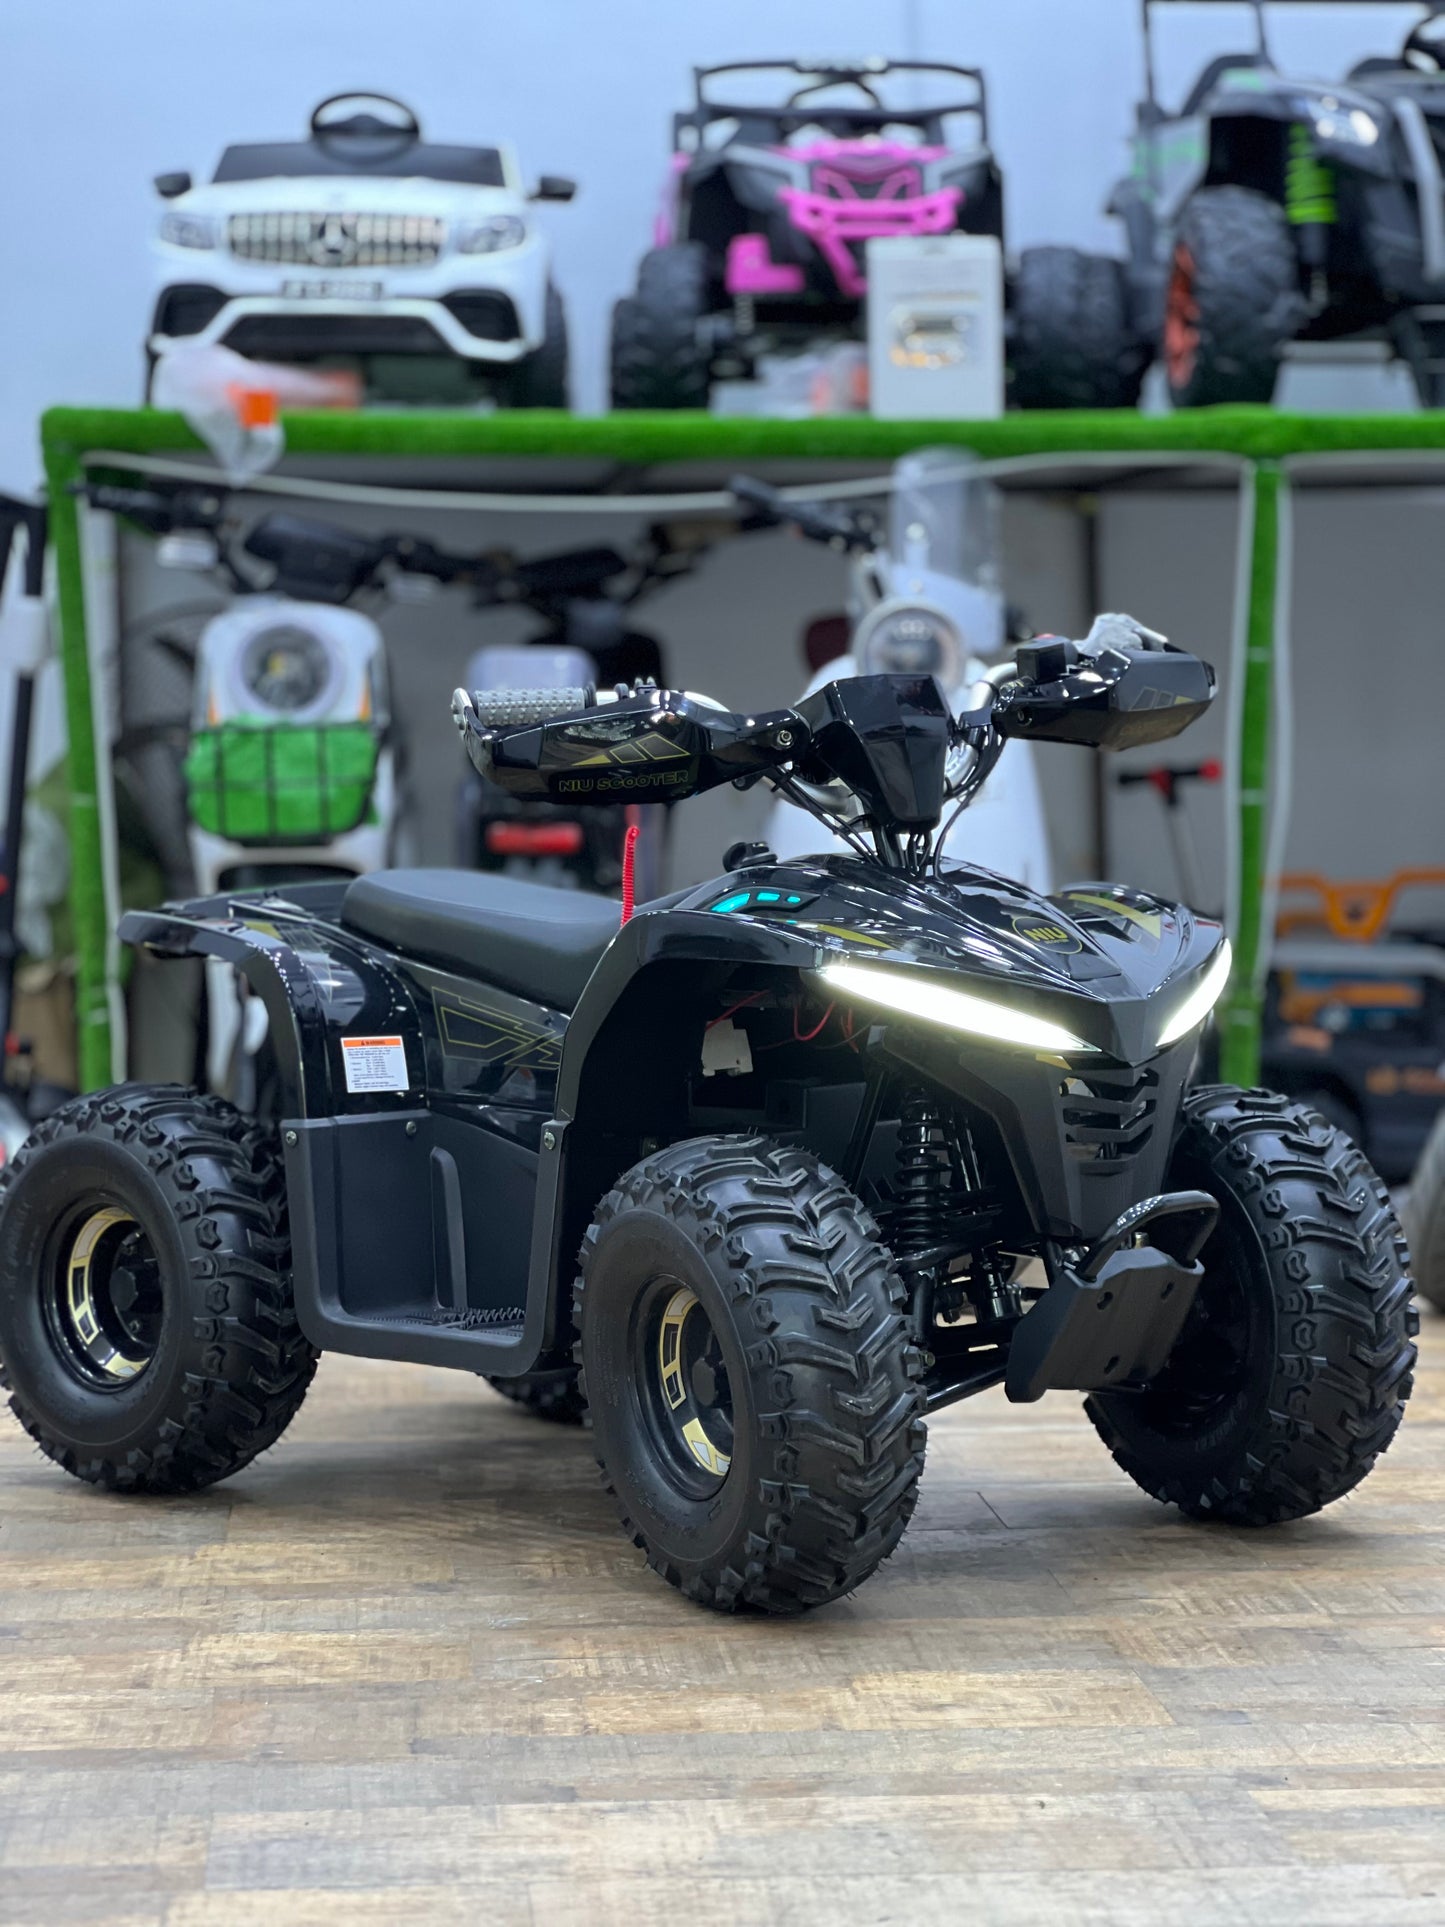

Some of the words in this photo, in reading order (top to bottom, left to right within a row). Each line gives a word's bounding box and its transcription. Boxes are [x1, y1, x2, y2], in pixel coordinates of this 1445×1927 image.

[559, 779, 594, 793] NIU
[597, 770, 689, 791] SCOOTER
[1023, 927, 1068, 941] NIU
